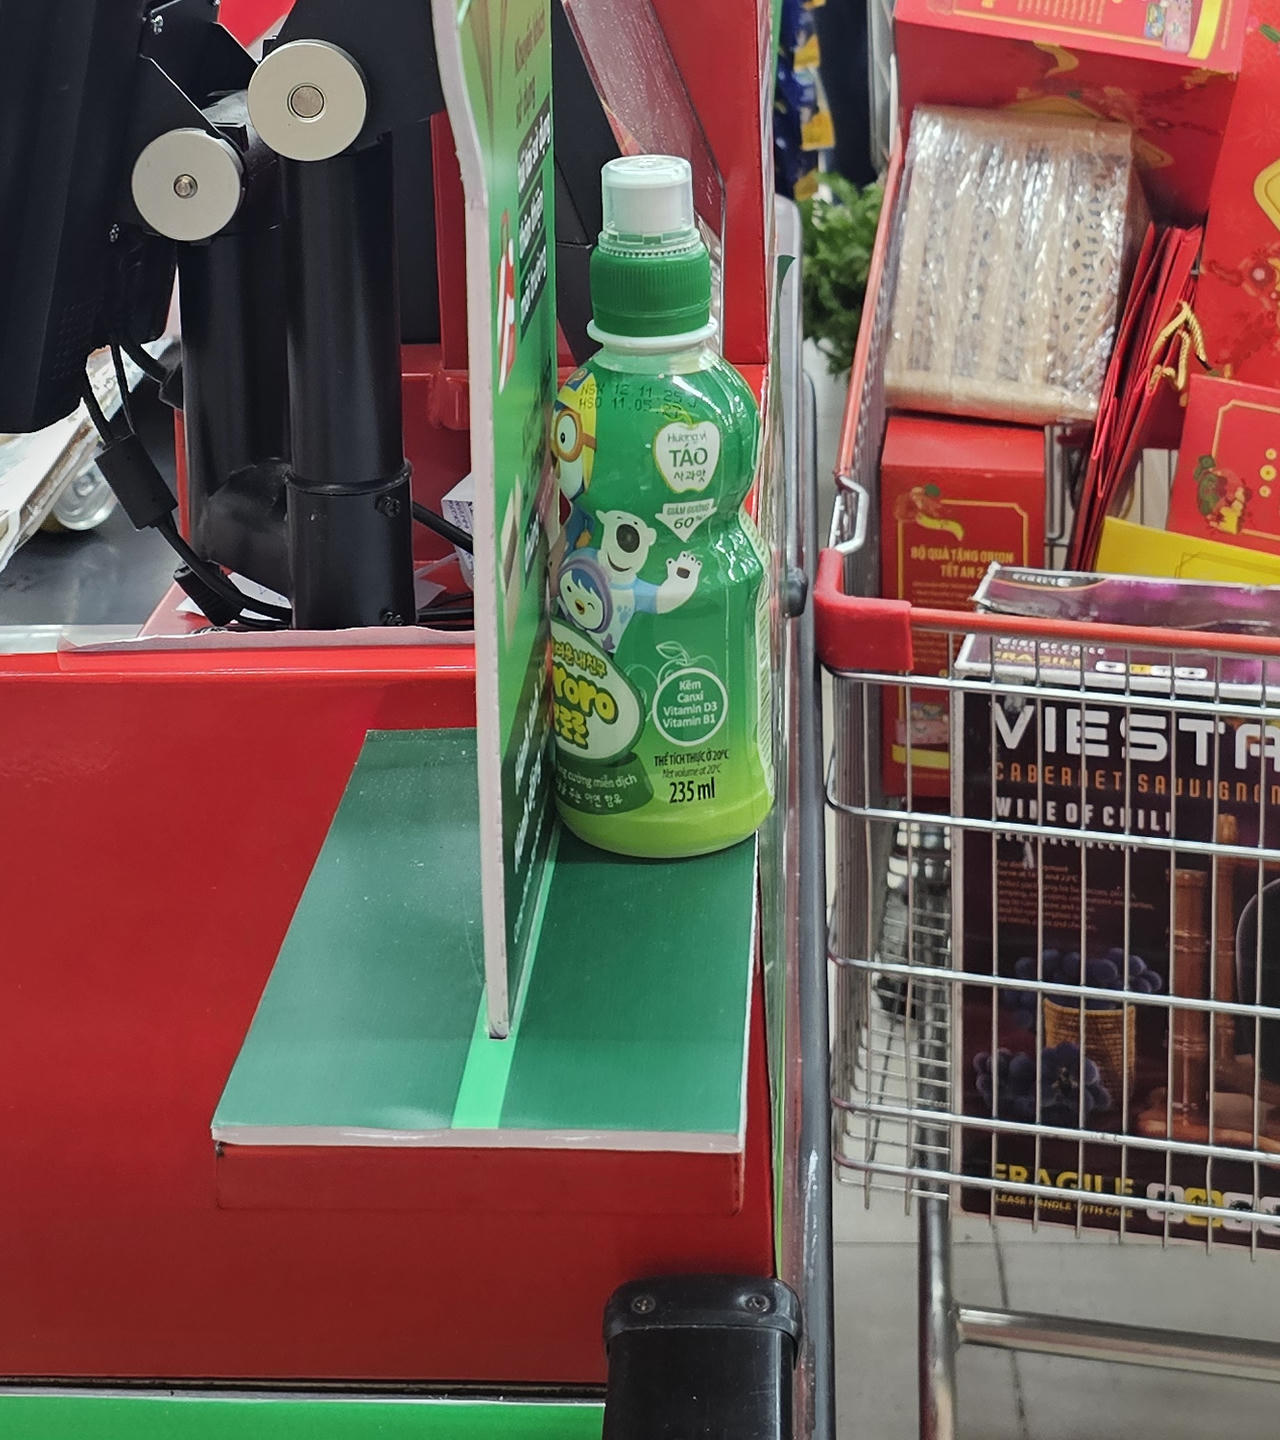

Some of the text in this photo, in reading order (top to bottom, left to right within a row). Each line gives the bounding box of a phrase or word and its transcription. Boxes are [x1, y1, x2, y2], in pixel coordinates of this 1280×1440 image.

[668, 443, 709, 468] TÁO
[553, 666, 617, 723] roro
[679, 678, 702, 691] Kẽm
[663, 701, 718, 717] Vitamin D3
[676, 691, 705, 704] Canxi
[662, 713, 716, 729] Vitamin B1
[995, 761, 1122, 792] CABERNET
[669, 777, 716, 805] 235 ml
[995, 796, 1056, 822] WINE
[1065, 803, 1094, 825] OF
[994, 1162, 1135, 1196] FRAGILE
[995, 1193, 1028, 1206] LEASE
[1029, 1198, 1072, 1211] ANDLE
